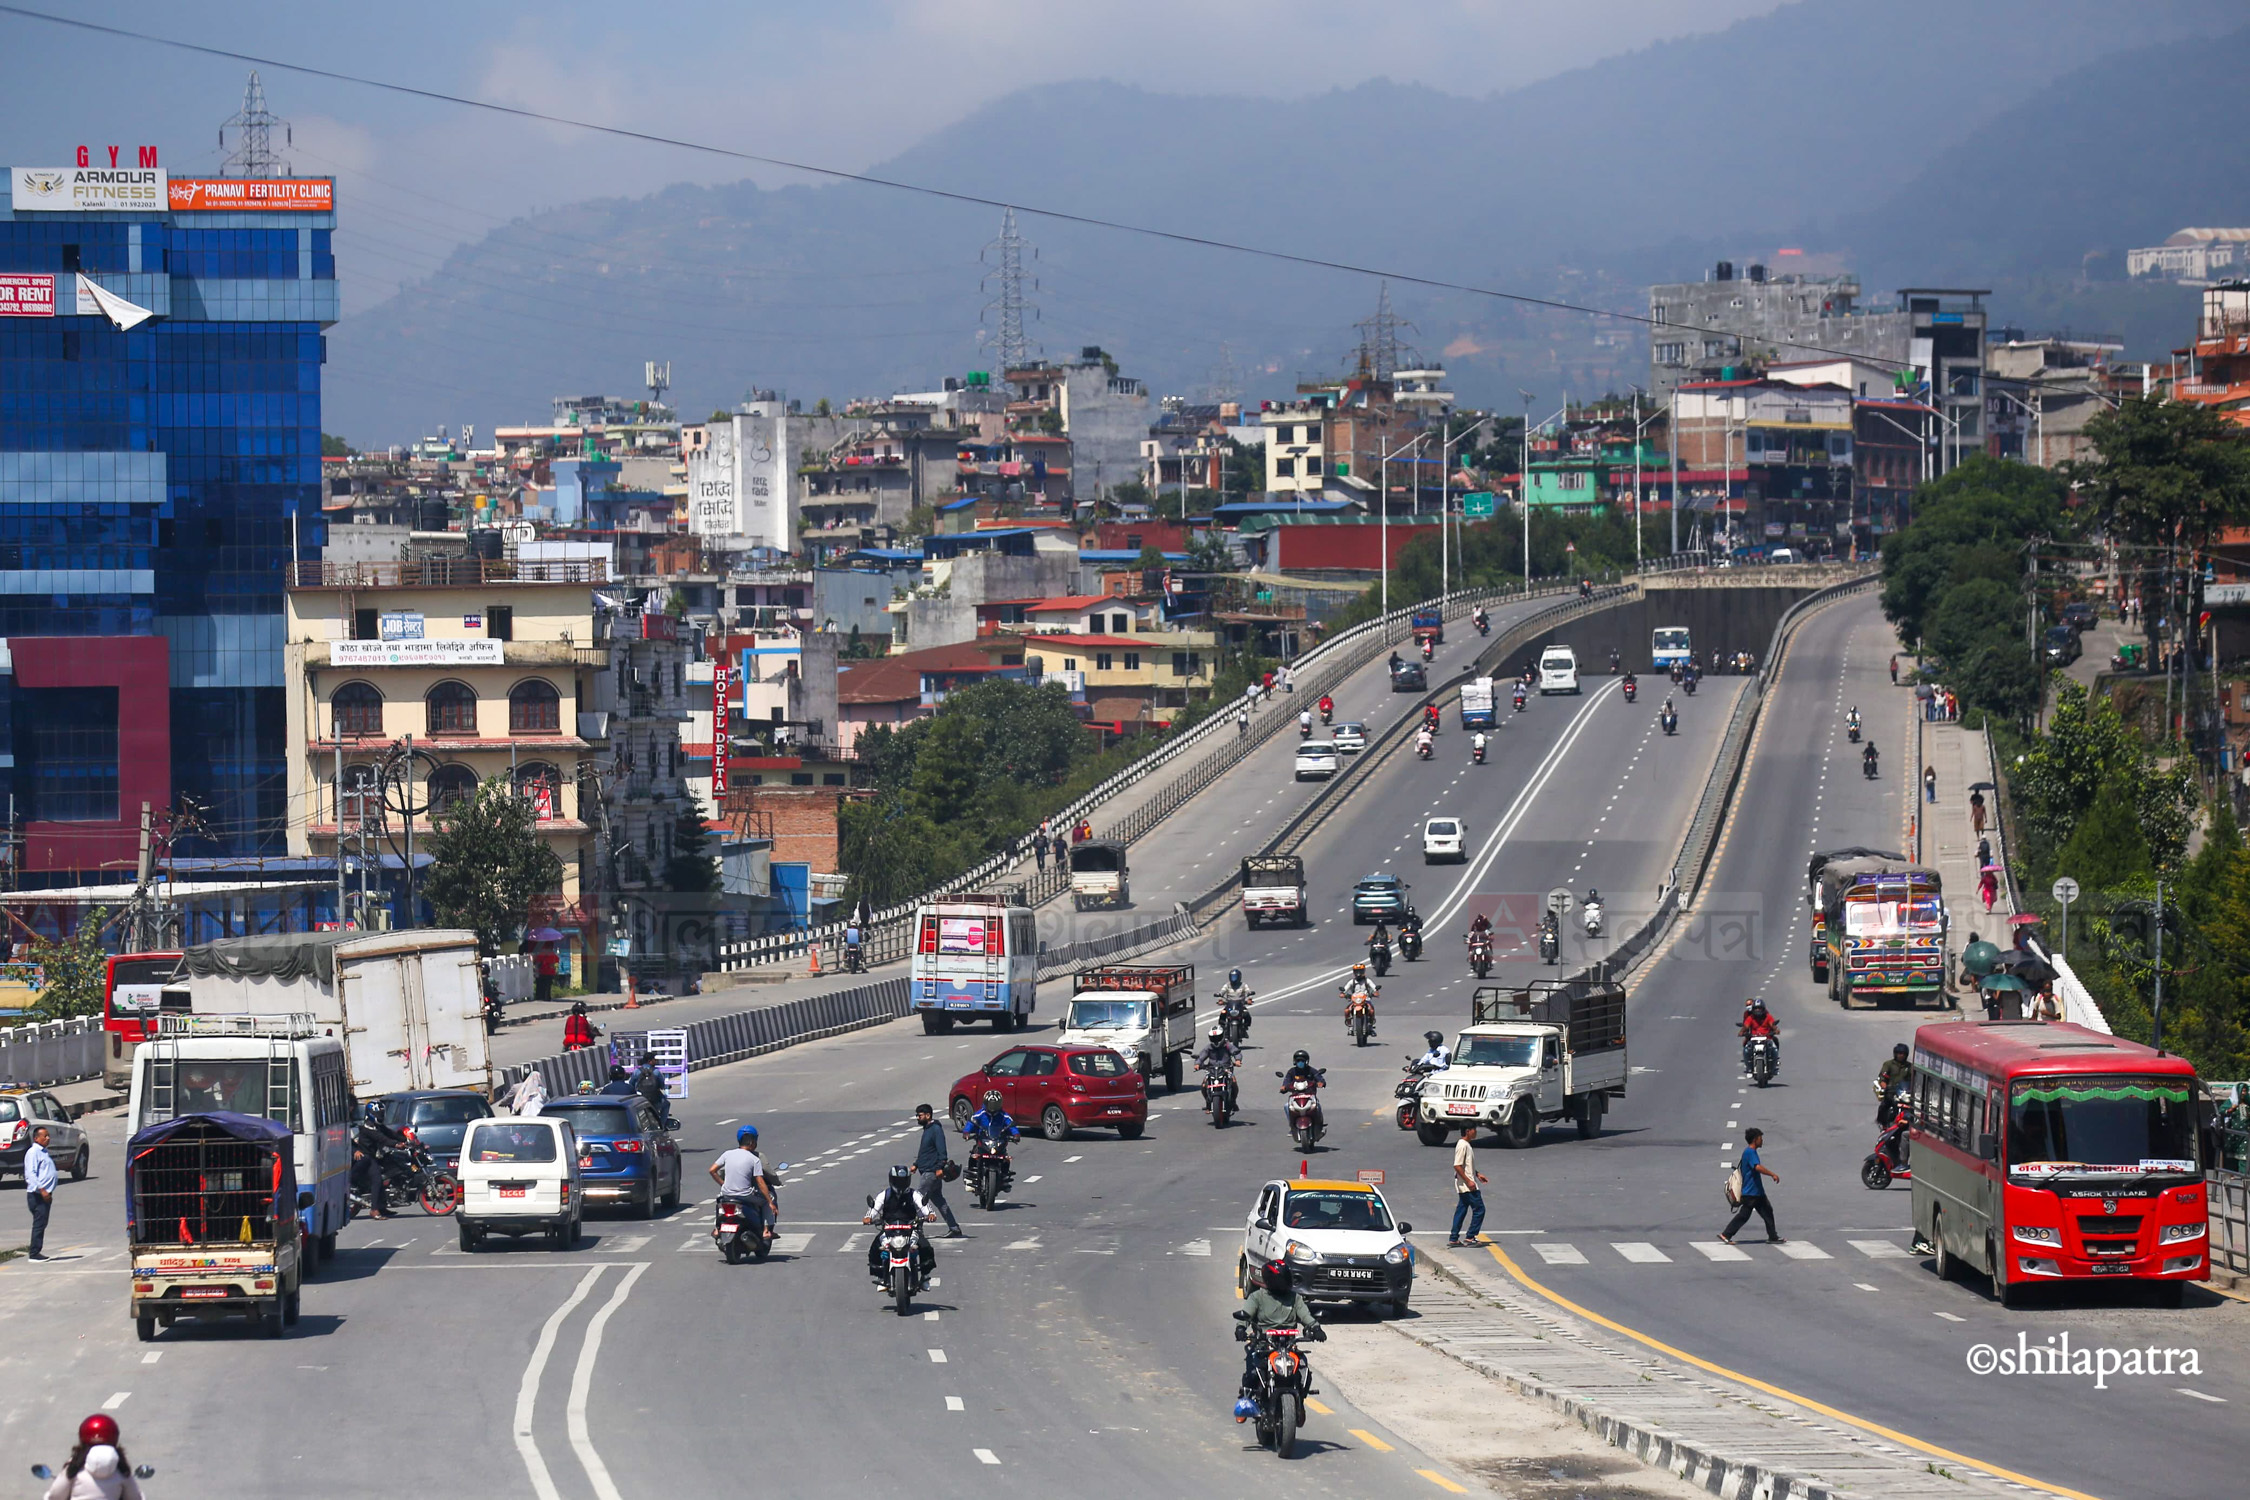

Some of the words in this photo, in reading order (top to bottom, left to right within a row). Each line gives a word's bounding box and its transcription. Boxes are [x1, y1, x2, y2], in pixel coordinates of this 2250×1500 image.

[74, 171, 156, 183] ARMOUR
[73, 186, 156, 199] FITNESS
[205, 184, 245, 198] PRANAVI
[250, 184, 297, 198] FERTILITY
[300, 184, 331, 198] CLINIC
[31, 278, 52, 286] SPACE
[18, 287, 52, 302] RENT
[383, 619, 403, 633] JOB
[339, 642, 358, 652] कोठा
[386, 643, 400, 652] तथा
[405, 643, 432, 652] भाडामा
[469, 641, 494, 652] अफिस
[715, 669, 727, 729] HOTEL
[714, 732, 726, 791] DELTA
[191, 1258, 217, 1266] TATA
